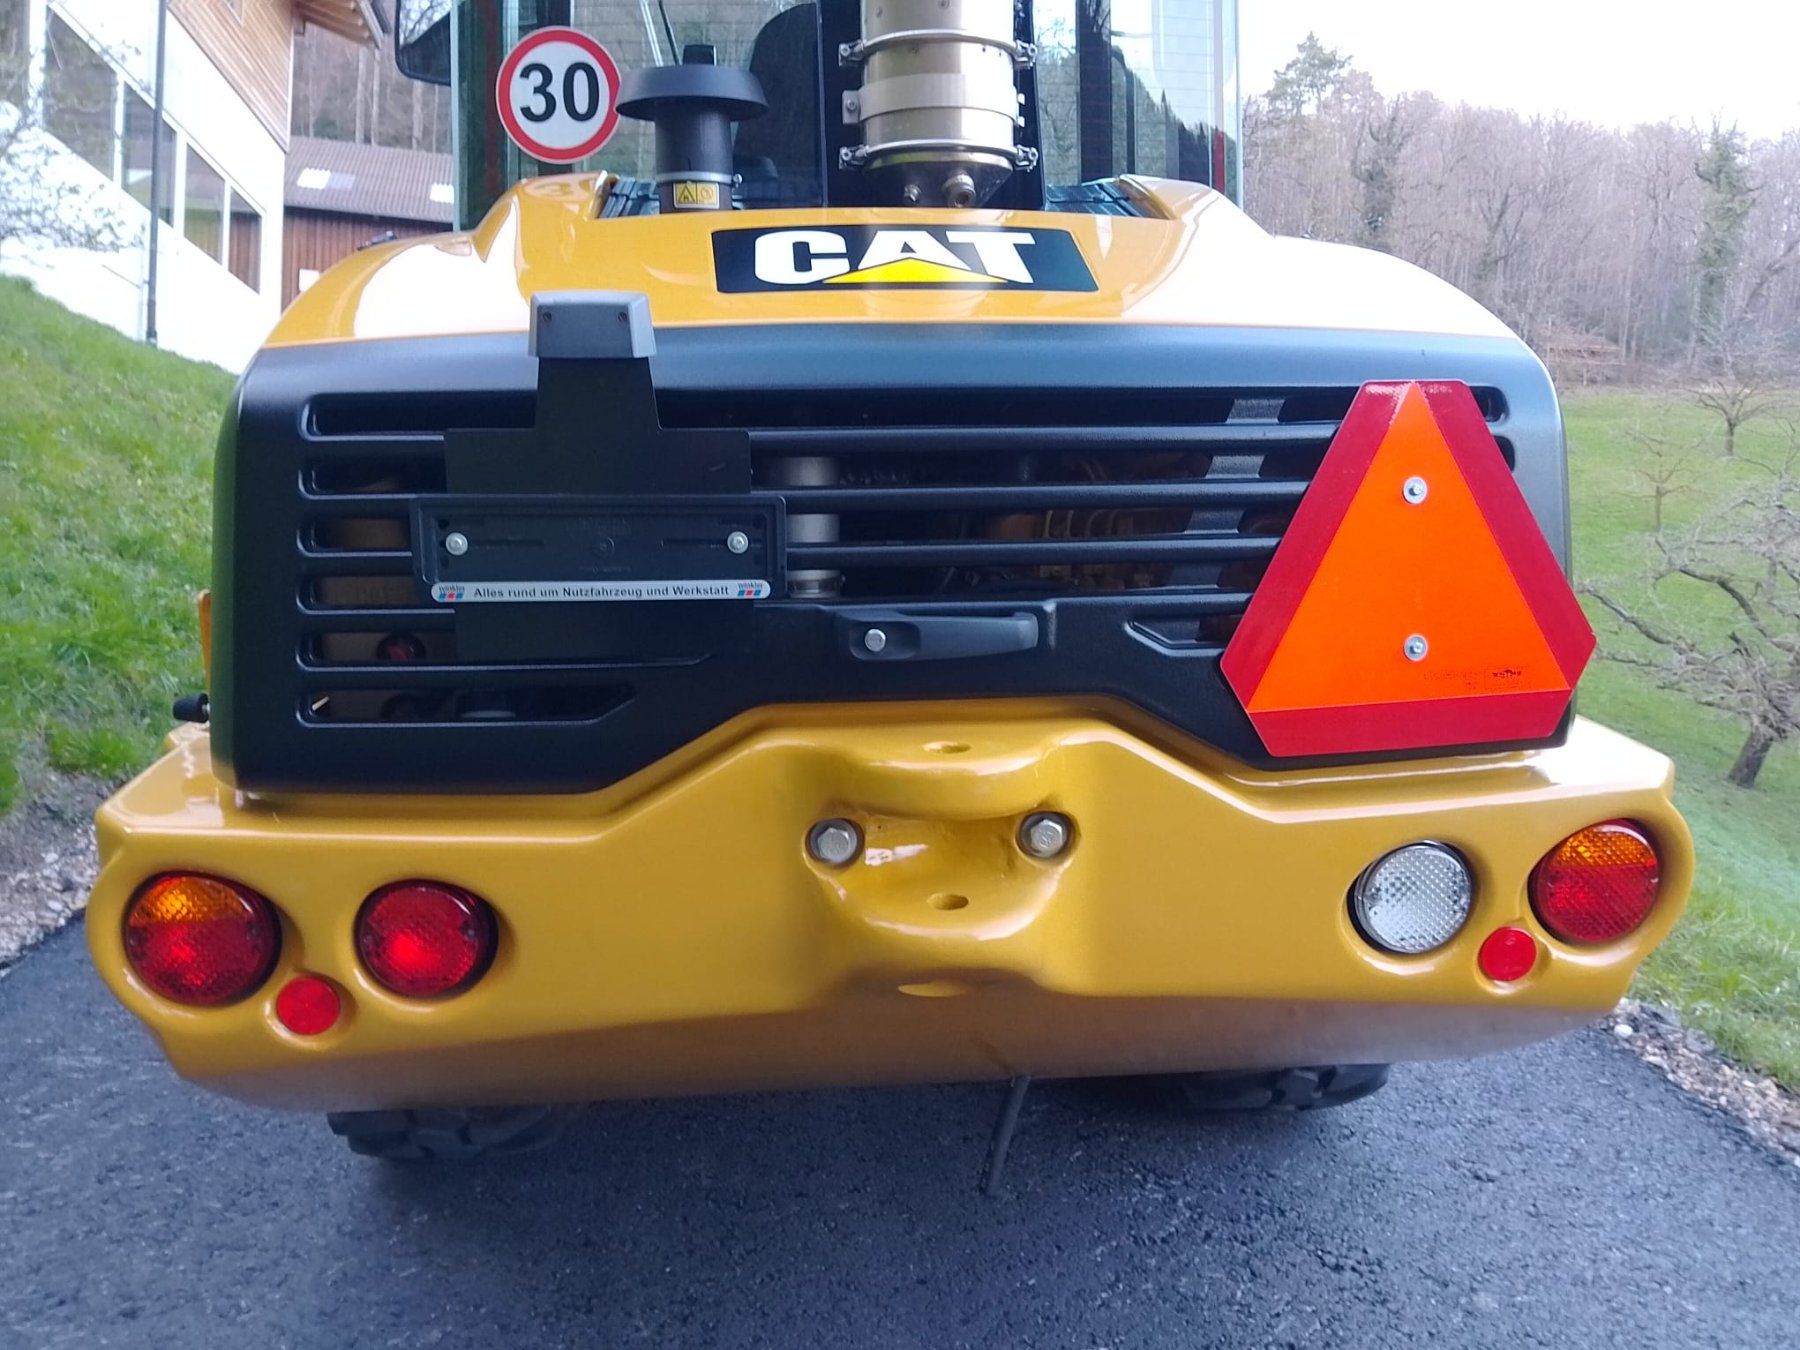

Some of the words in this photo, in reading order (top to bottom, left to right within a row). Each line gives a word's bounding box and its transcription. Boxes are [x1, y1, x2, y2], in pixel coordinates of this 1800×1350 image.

[519, 62, 600, 123] 30
[754, 230, 1036, 285] CAT
[473, 587, 504, 598] Alles
[508, 586, 536, 598] rund
[540, 588, 559, 598] um
[562, 585, 643, 598] Nutzfahrzeug
[646, 585, 669, 596] und
[672, 584, 729, 596] Werkstatt
